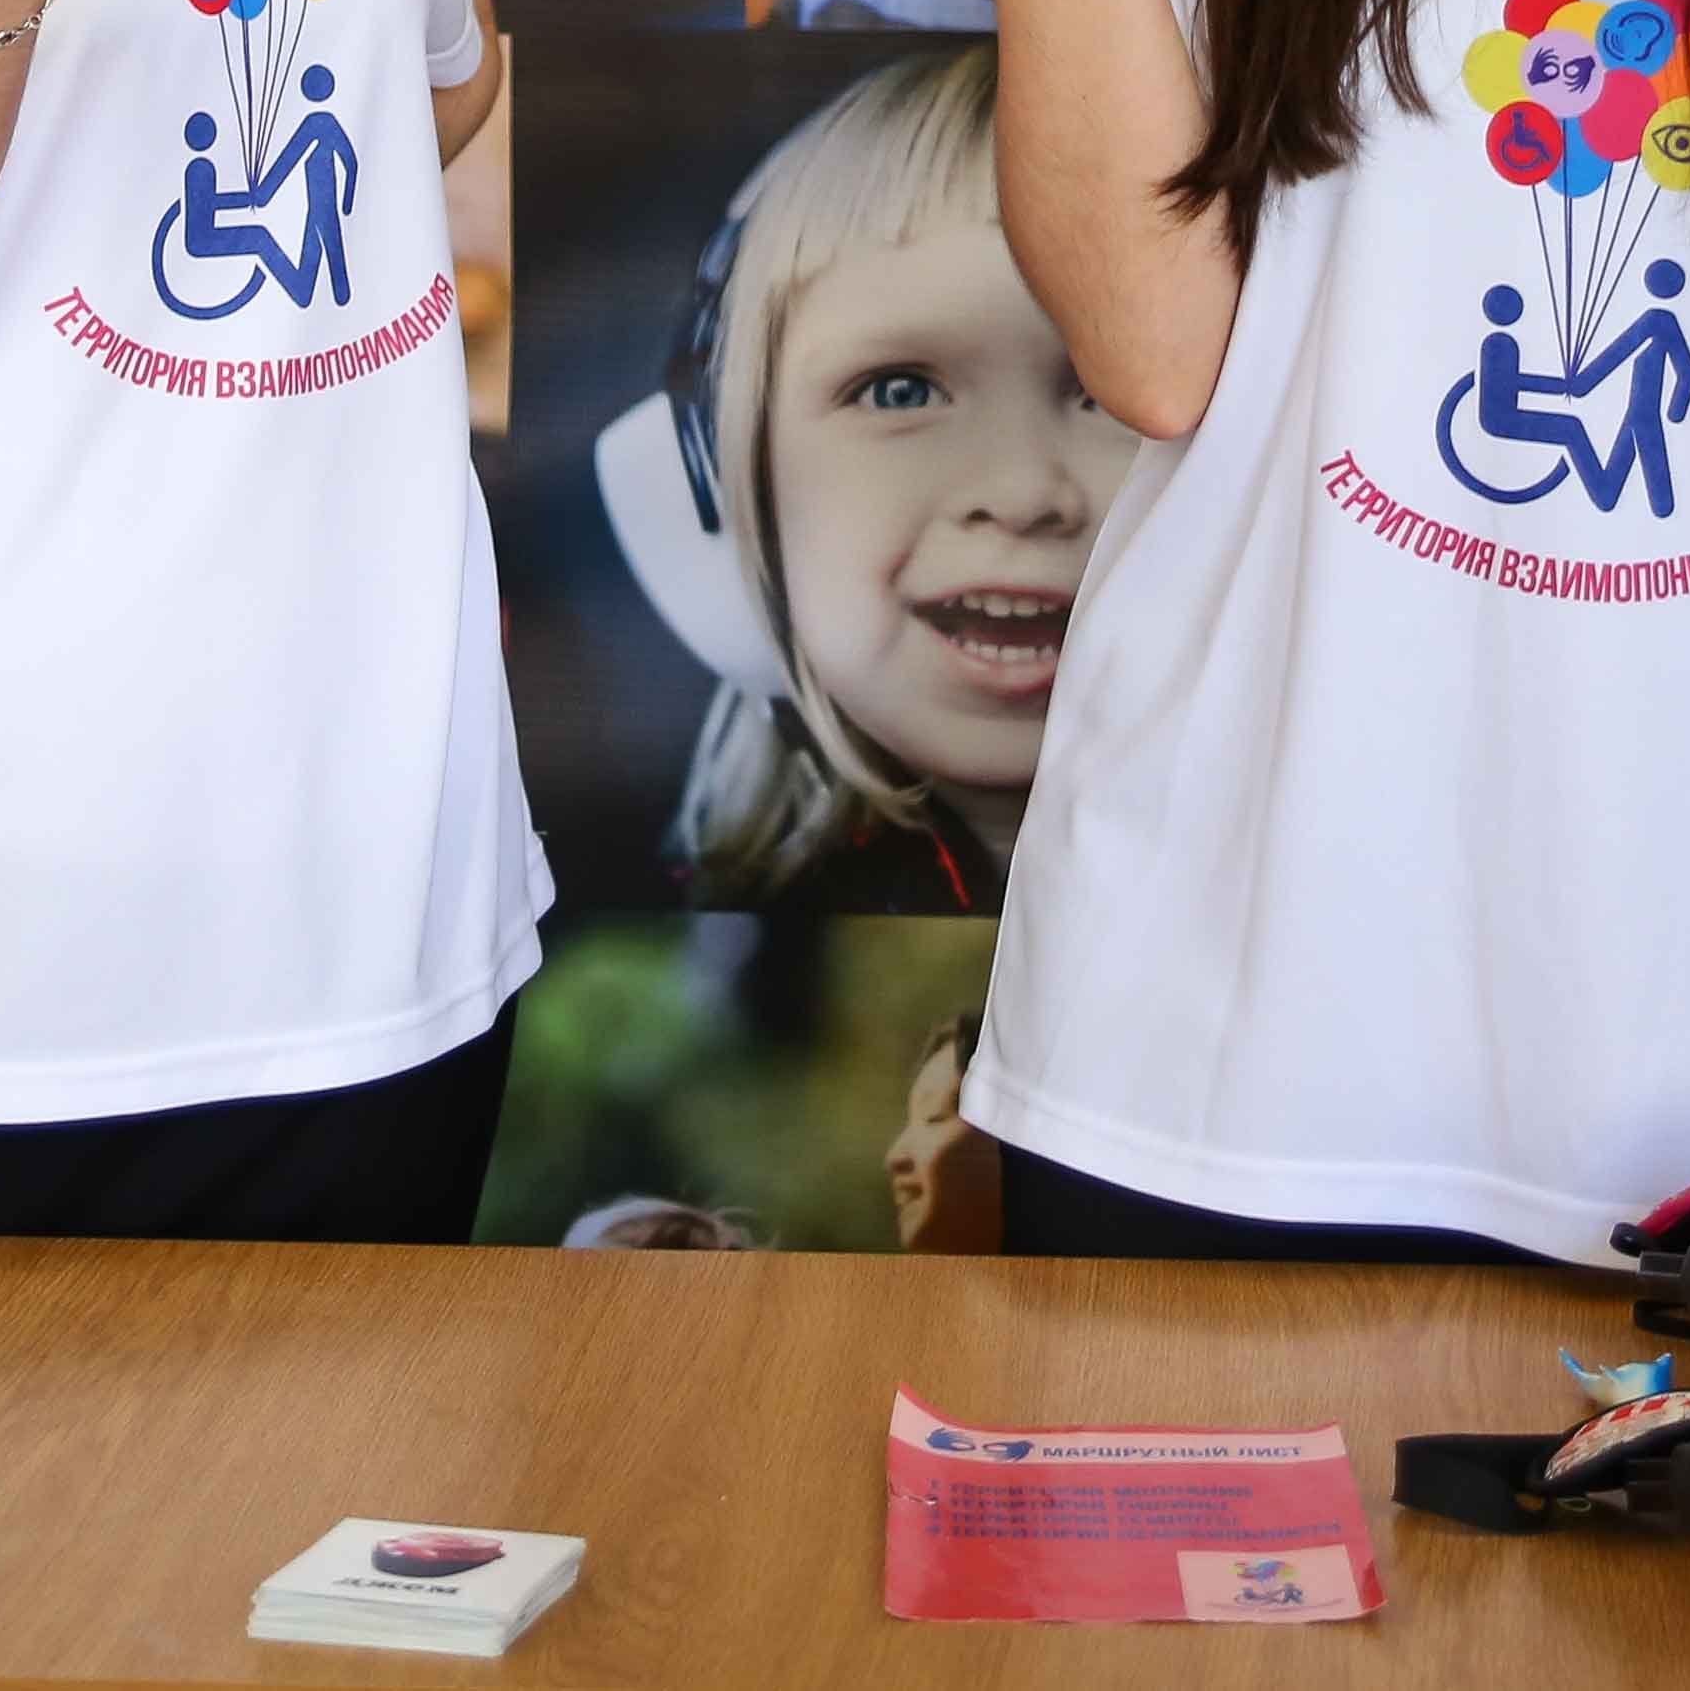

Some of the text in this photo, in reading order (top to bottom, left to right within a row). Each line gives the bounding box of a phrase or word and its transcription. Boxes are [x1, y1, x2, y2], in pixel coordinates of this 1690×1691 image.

[44, 273, 455, 399] ТЕРРИТОРИЯ ВЗАИМОПОНИМАНИЯ
[1320, 450, 1496, 579] ТЕРРИТОРИЯ
